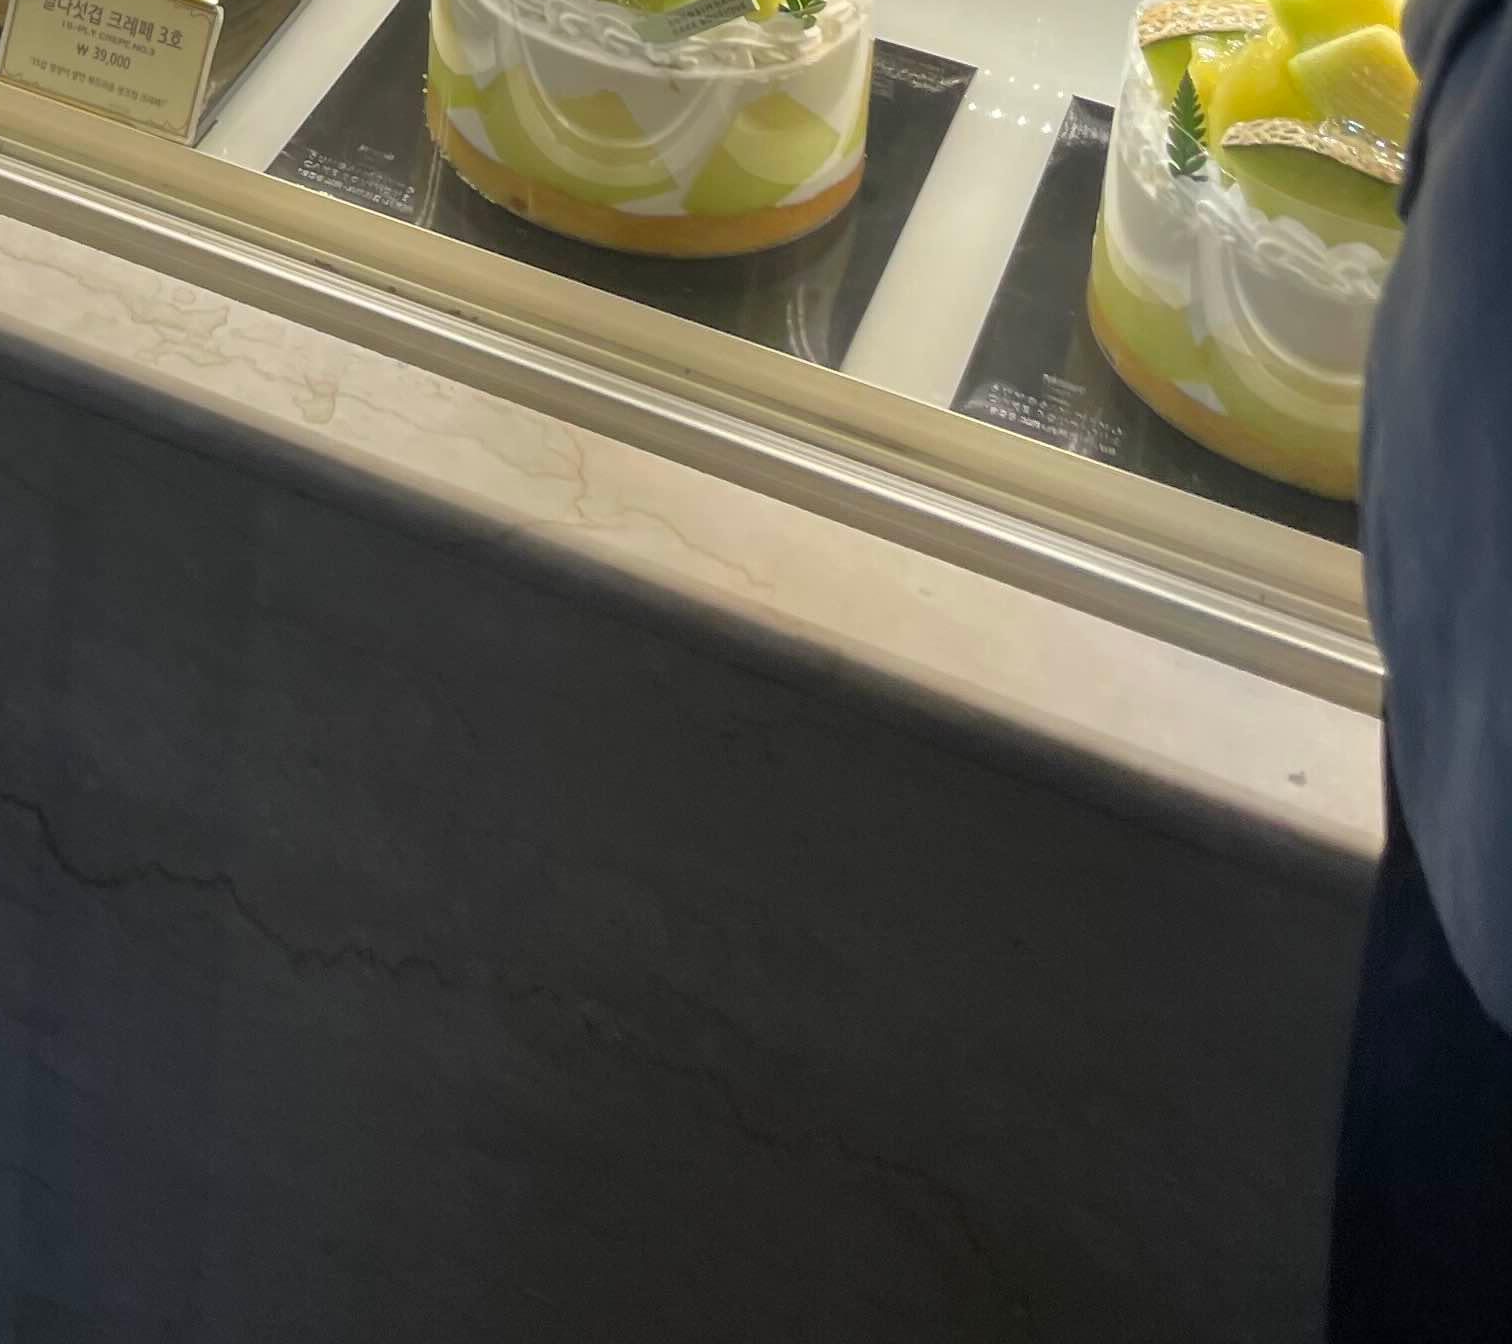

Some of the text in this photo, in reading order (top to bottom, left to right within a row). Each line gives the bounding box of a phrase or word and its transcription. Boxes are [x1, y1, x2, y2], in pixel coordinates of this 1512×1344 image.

[107, 10, 154, 42] 크레페
[157, 26, 184, 51] 3호
[92, 45, 132, 71] 39,000
